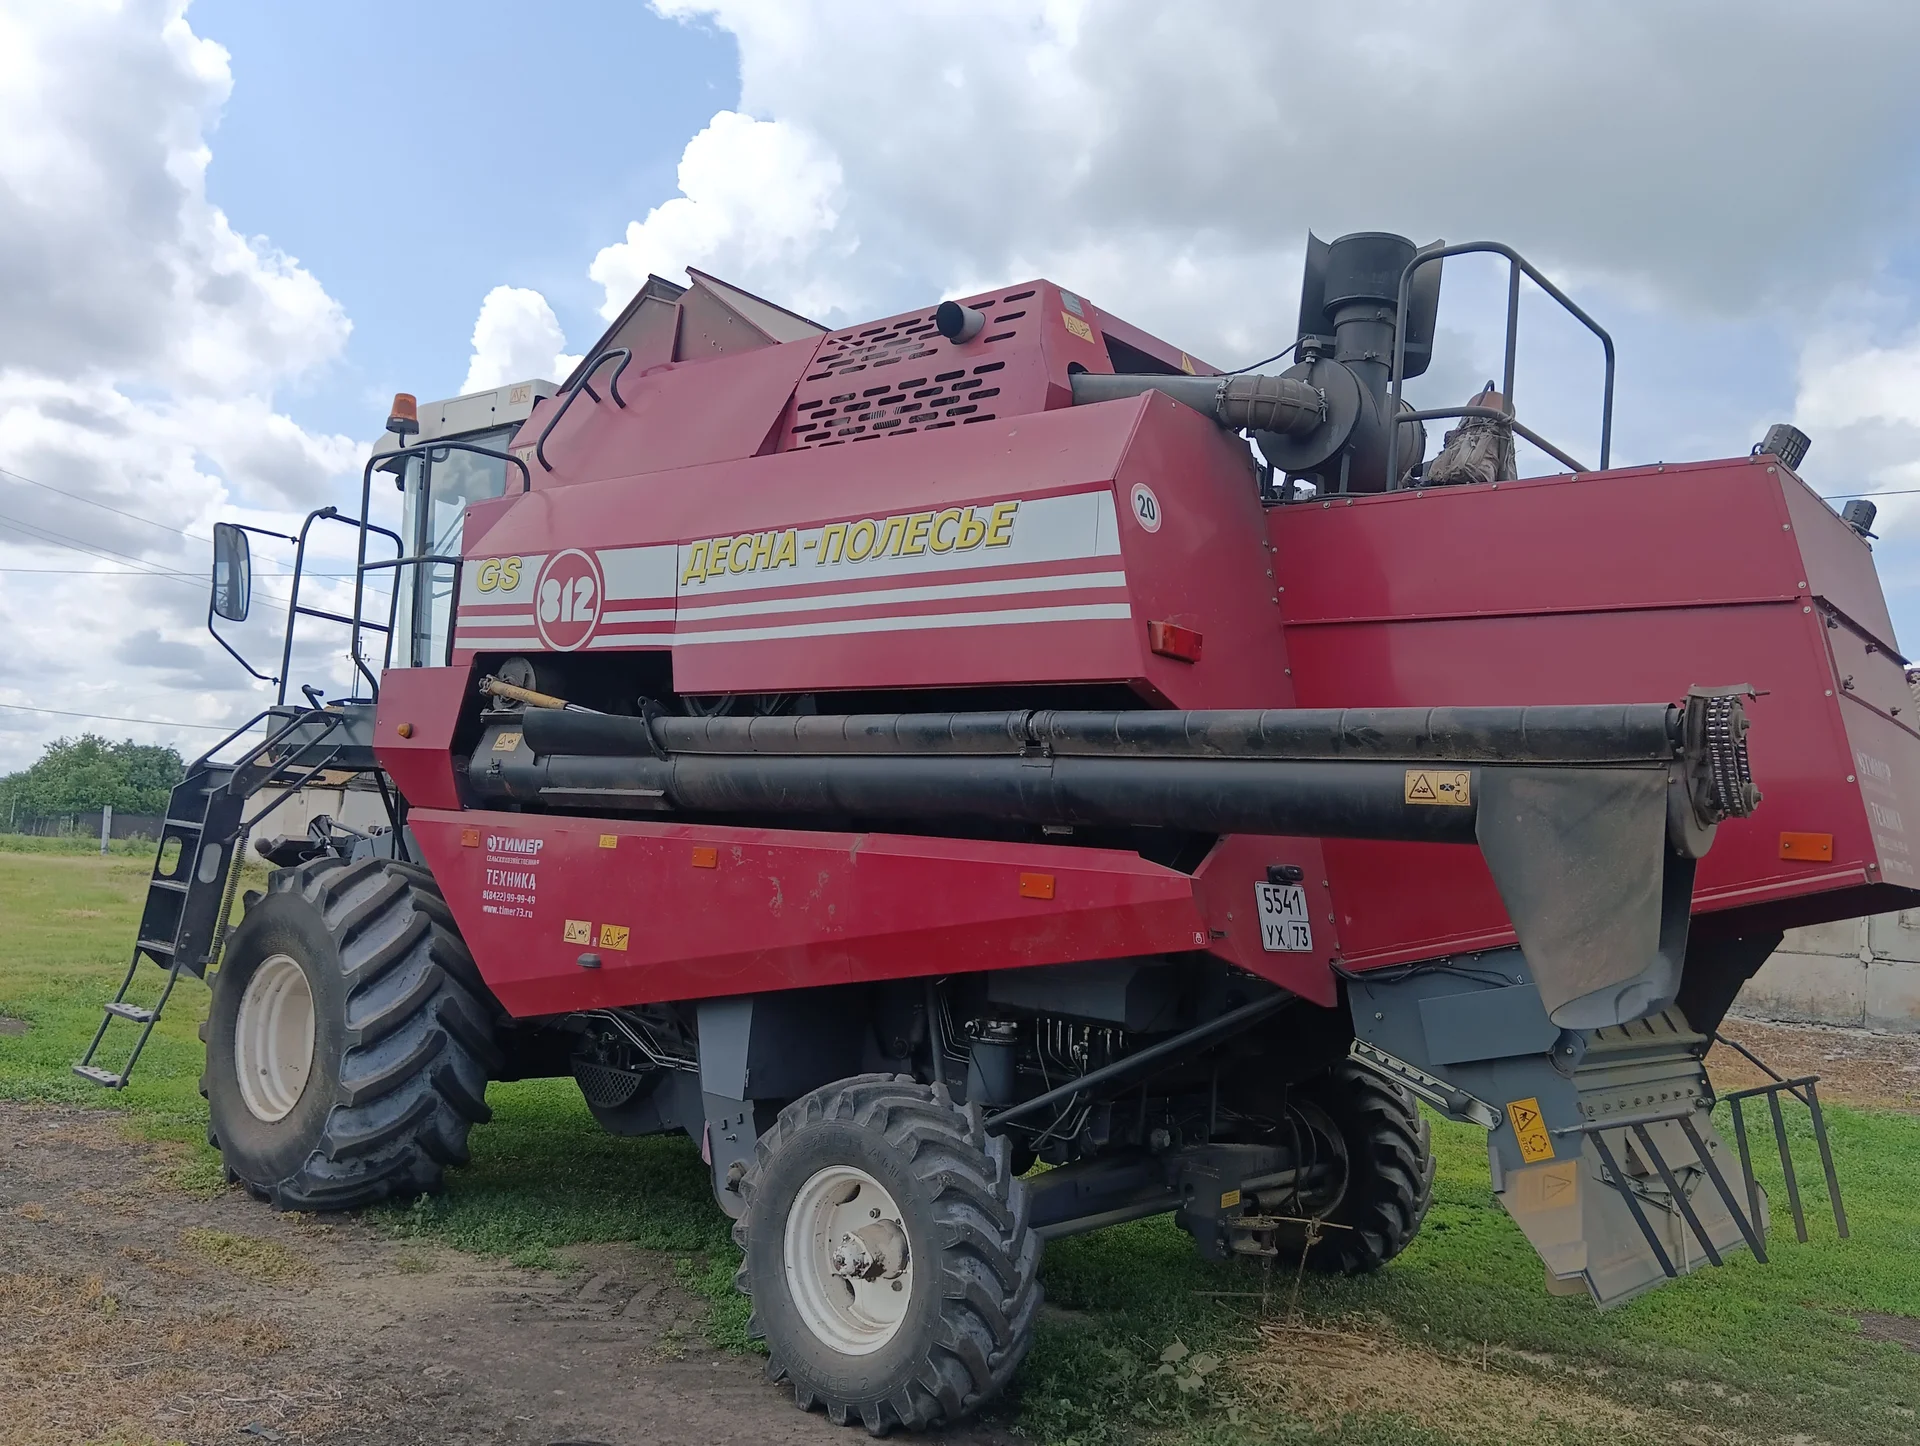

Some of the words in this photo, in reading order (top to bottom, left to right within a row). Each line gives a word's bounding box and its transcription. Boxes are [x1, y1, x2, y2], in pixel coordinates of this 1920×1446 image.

[1137, 494, 1156, 520] 20
[680, 500, 1022, 586] ДЕСНА-ПОЛЕСЬЕ
[476, 556, 523, 593] GS
[540, 575, 595, 623] 812
[496, 836, 544, 855] ТИМЕР
[486, 868, 536, 890] ТЕХНИКА
[482, 904, 533, 918] www.timer73.ru
[1263, 887, 1302, 916] 5541
[1292, 926, 1309, 947] 73
[1521, 1136, 1531, 1155] STOP
